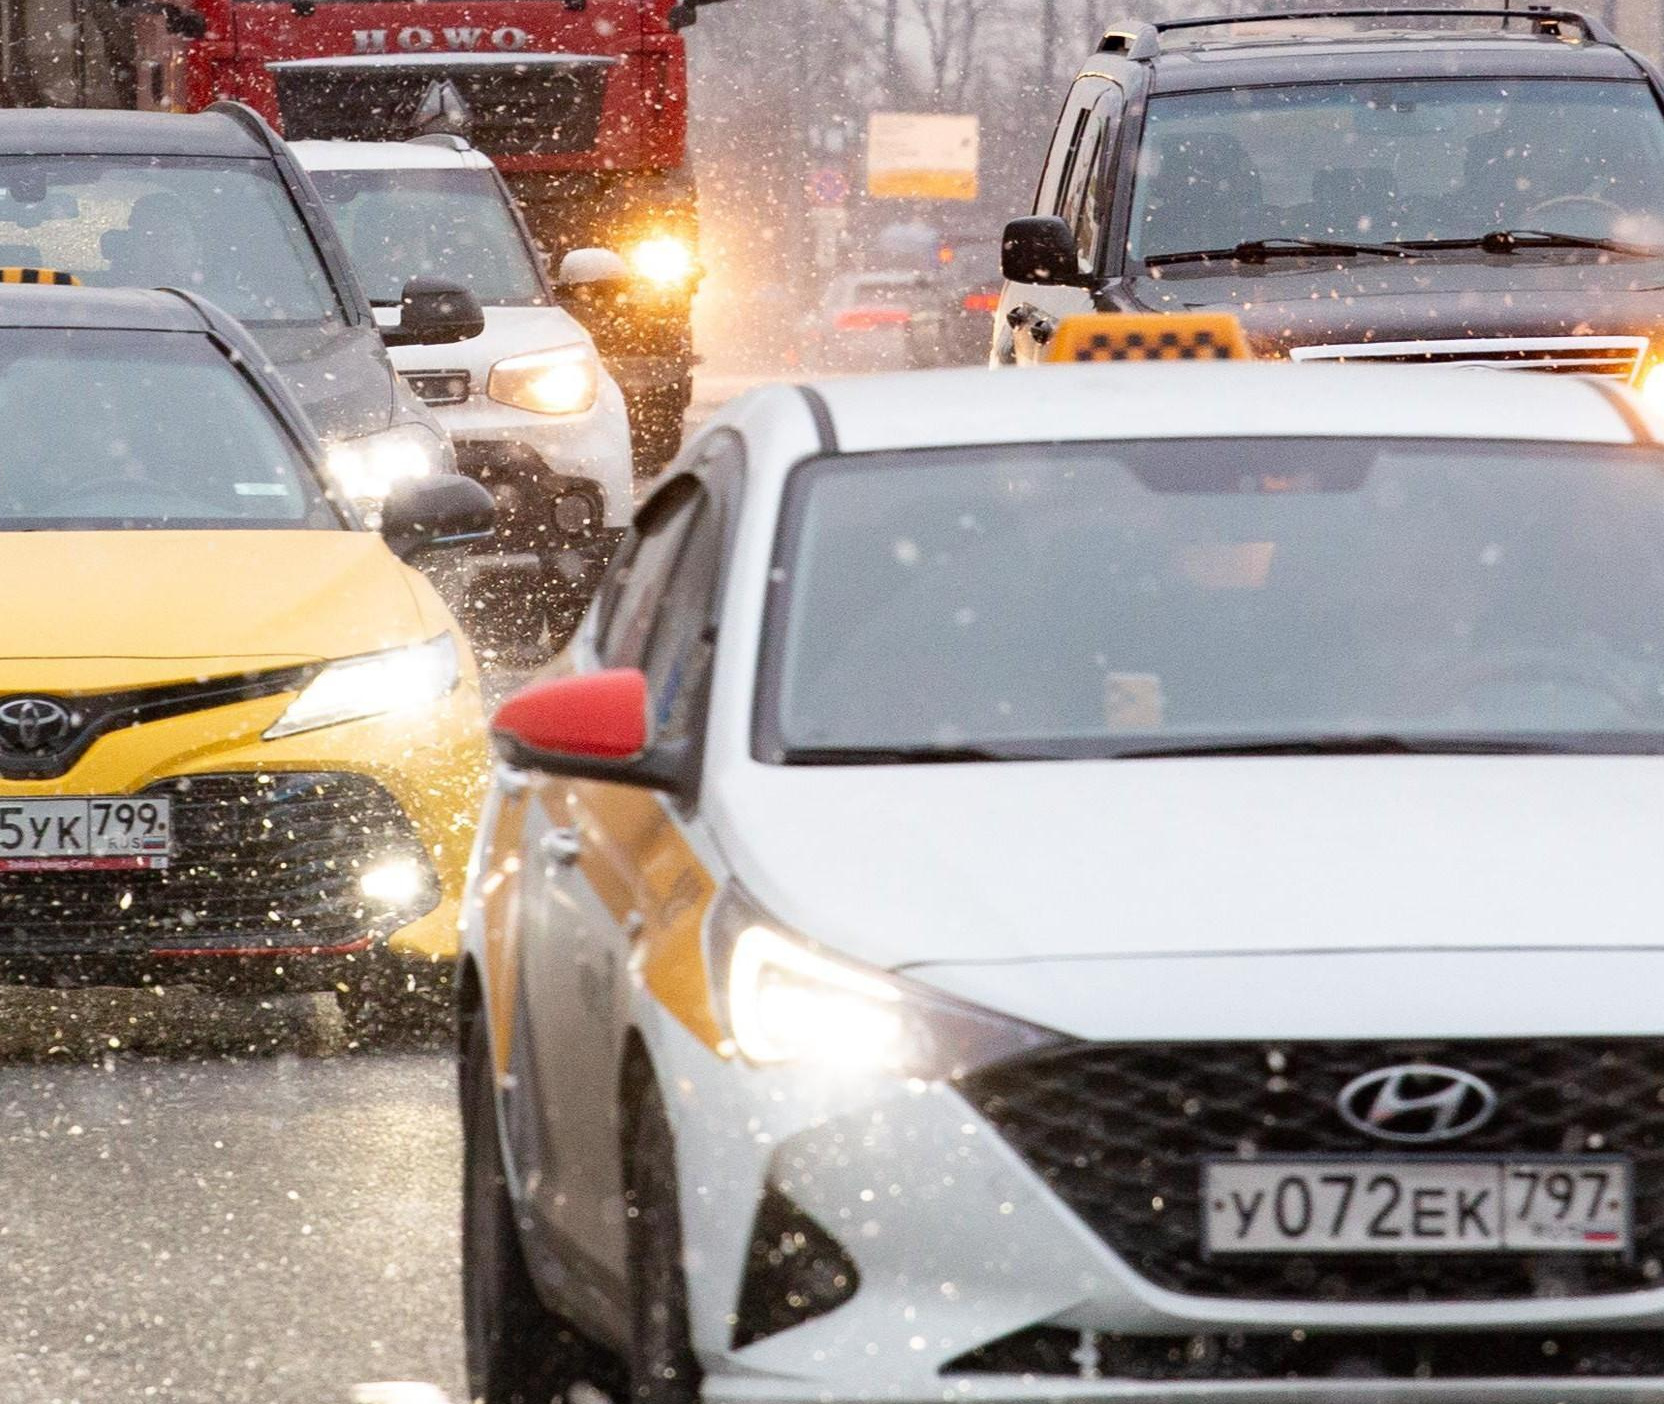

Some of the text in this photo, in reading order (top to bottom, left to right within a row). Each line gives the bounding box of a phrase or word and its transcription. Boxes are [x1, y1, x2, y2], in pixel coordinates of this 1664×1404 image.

[351, 26, 528, 53] HOWO
[93, 803, 159, 836] 799
[1231, 1171, 1610, 1239] У072ЕК 797
